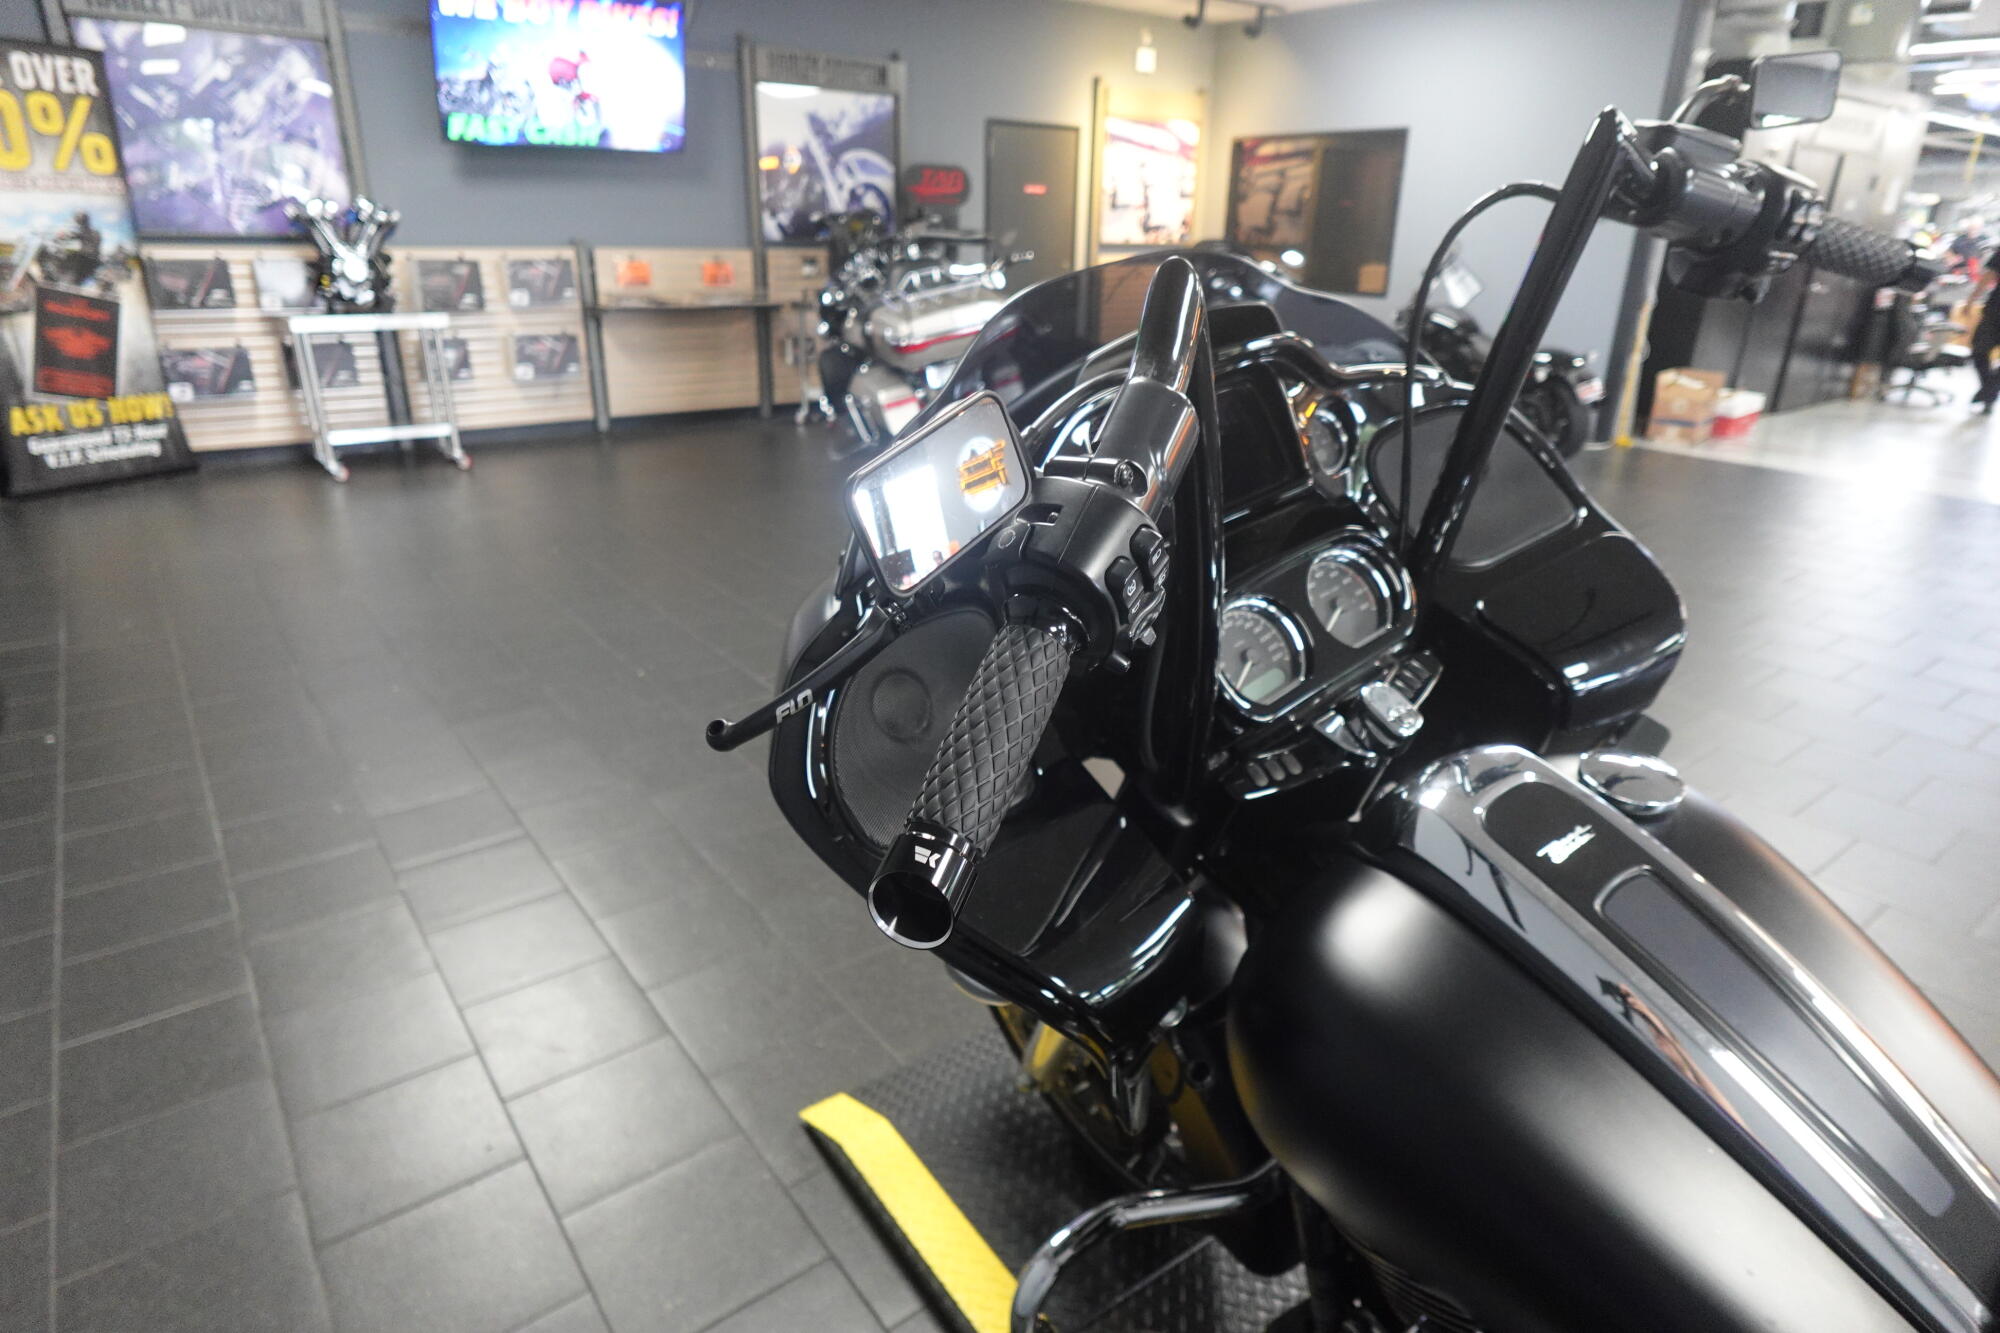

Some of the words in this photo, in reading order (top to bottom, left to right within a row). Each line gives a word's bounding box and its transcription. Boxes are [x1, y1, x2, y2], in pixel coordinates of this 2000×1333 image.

[9, 50, 99, 97] OVER
[447, 112, 522, 145] FAST
[524, 117, 600, 147] CASH
[10, 404, 65, 437] ASK
[67, 398, 105, 430] US
[107, 392, 175, 425] NOW!
